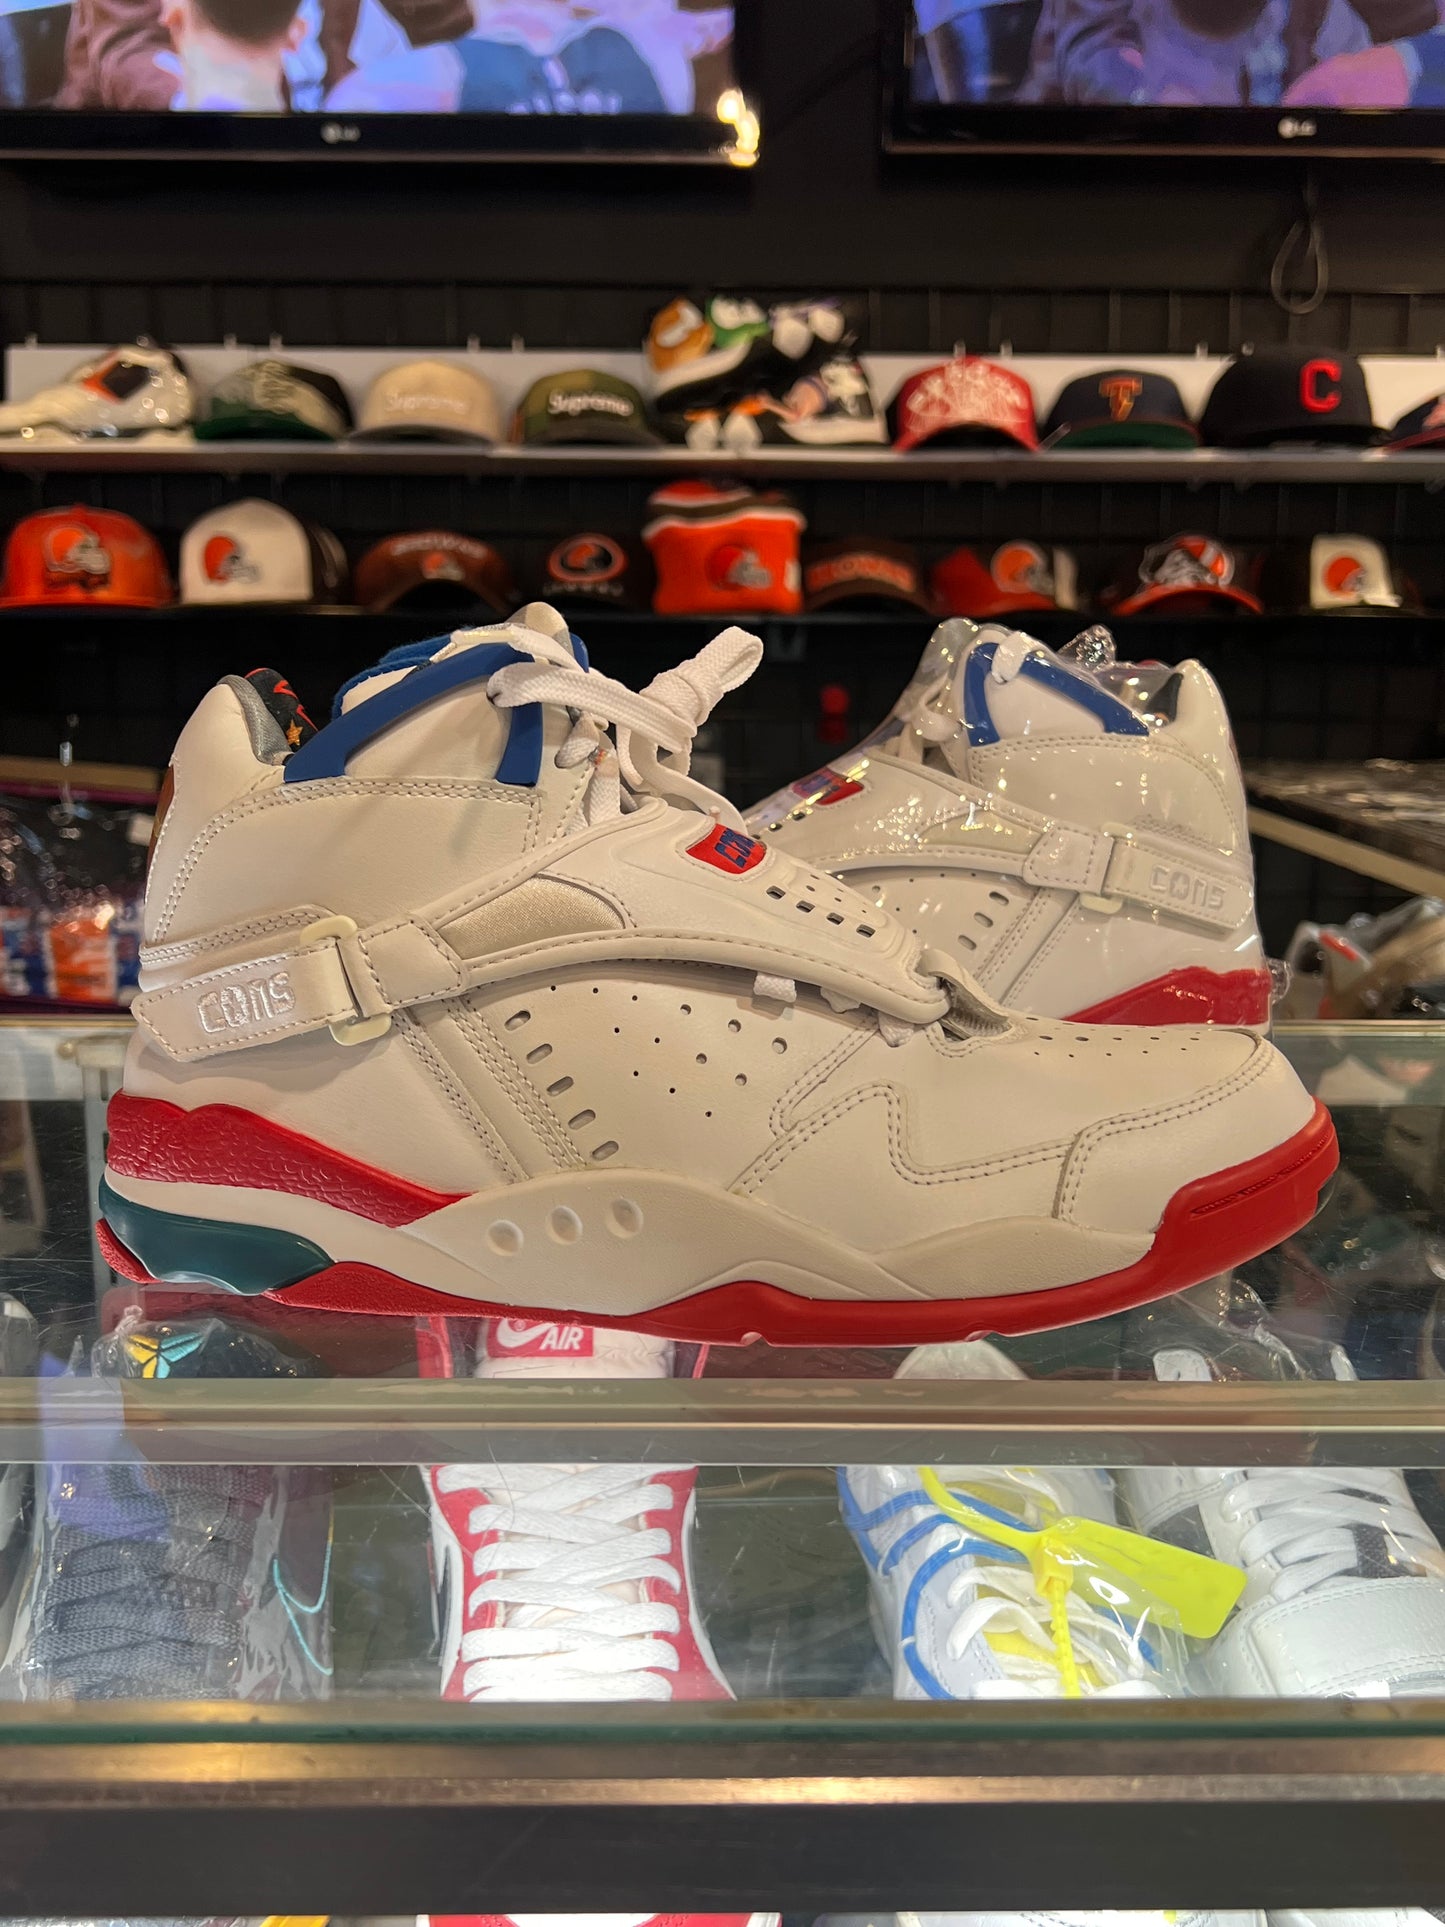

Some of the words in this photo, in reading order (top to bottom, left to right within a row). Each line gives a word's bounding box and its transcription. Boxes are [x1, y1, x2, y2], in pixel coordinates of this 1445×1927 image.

[1301, 358, 1341, 413] C
[547, 389, 634, 416] Supreme
[539, 1324, 585, 1350] AIR
